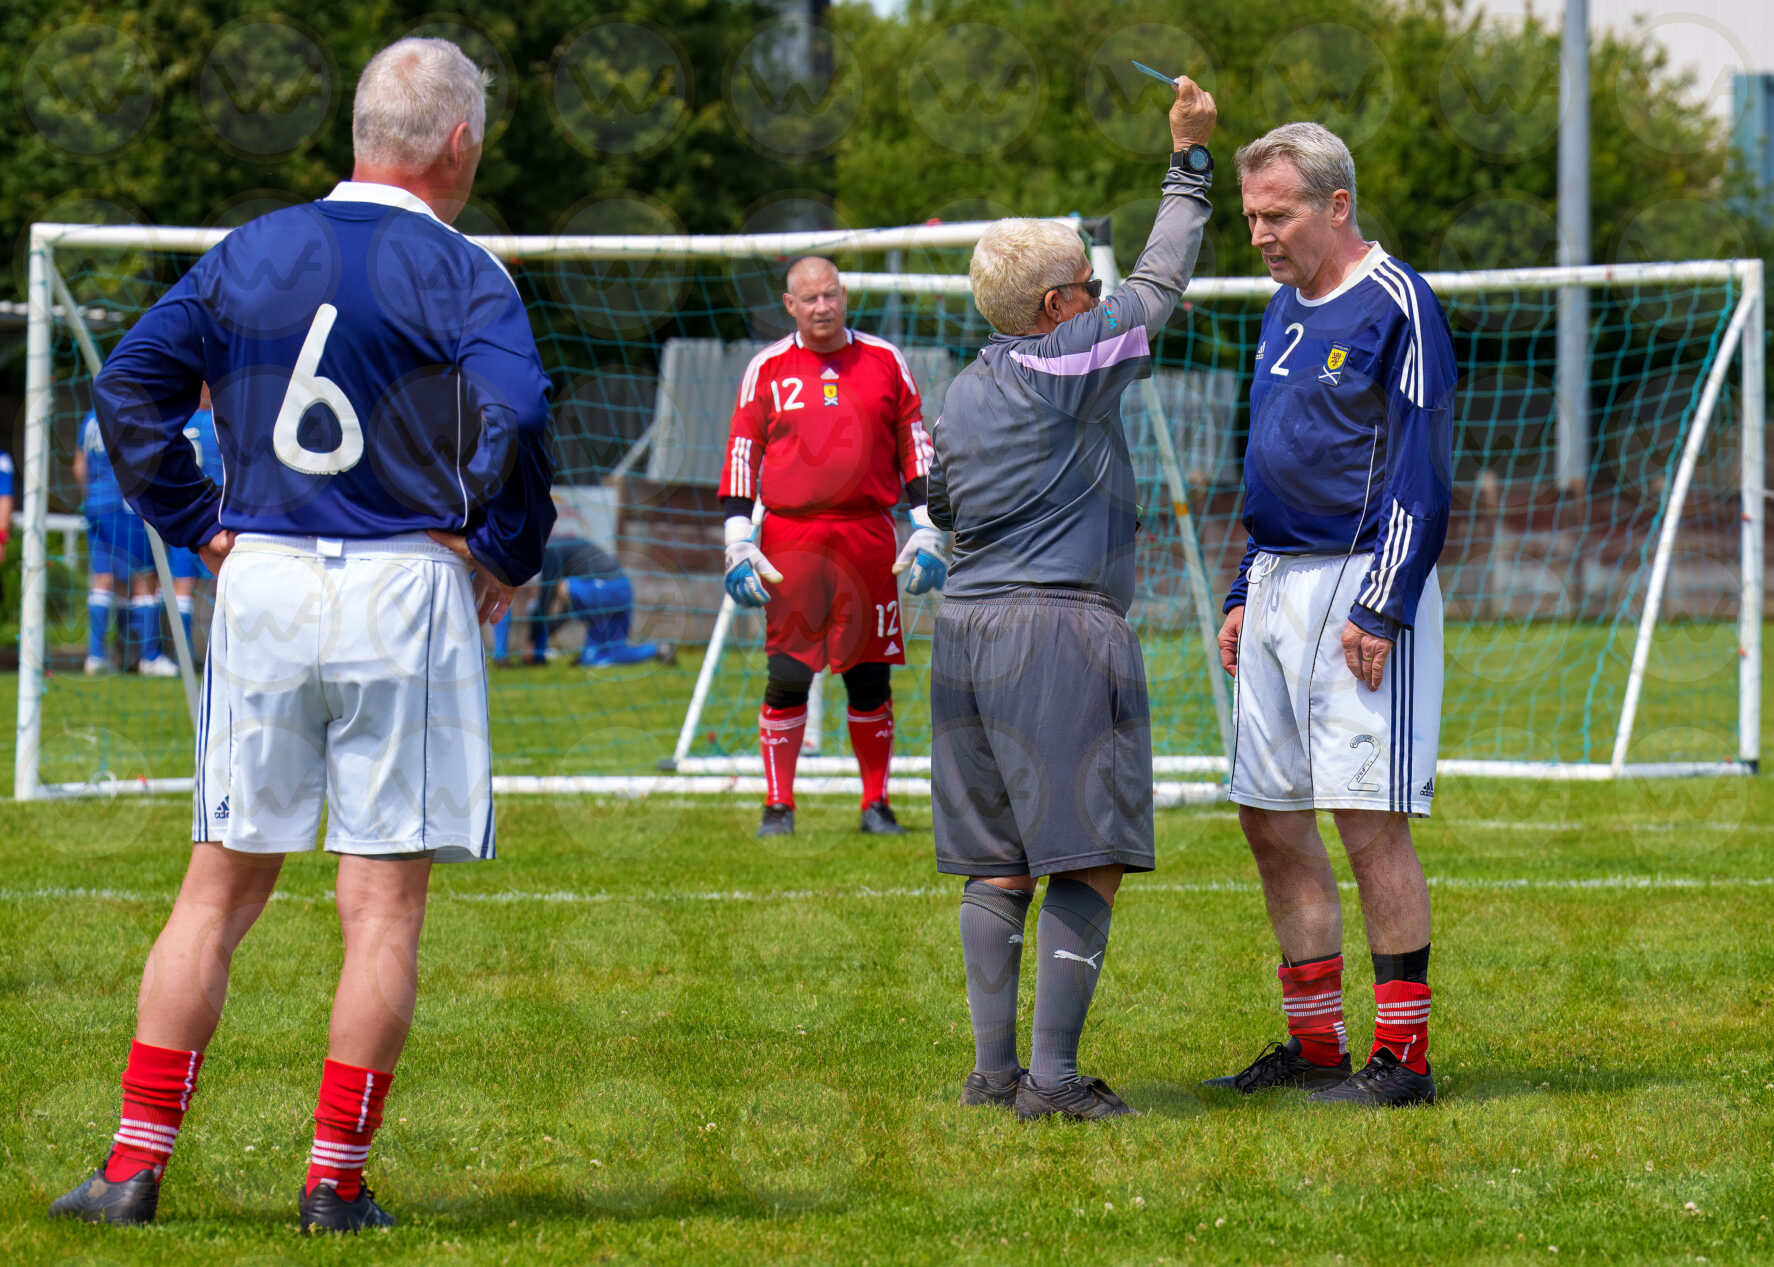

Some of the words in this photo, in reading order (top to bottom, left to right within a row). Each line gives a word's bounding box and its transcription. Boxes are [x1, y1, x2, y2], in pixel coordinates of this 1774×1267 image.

[1270, 322, 1304, 376] 2
[273, 303, 364, 475] 6
[770, 377, 805, 413] 12
[875, 600, 899, 638] 12
[1347, 734, 1380, 792] 2
